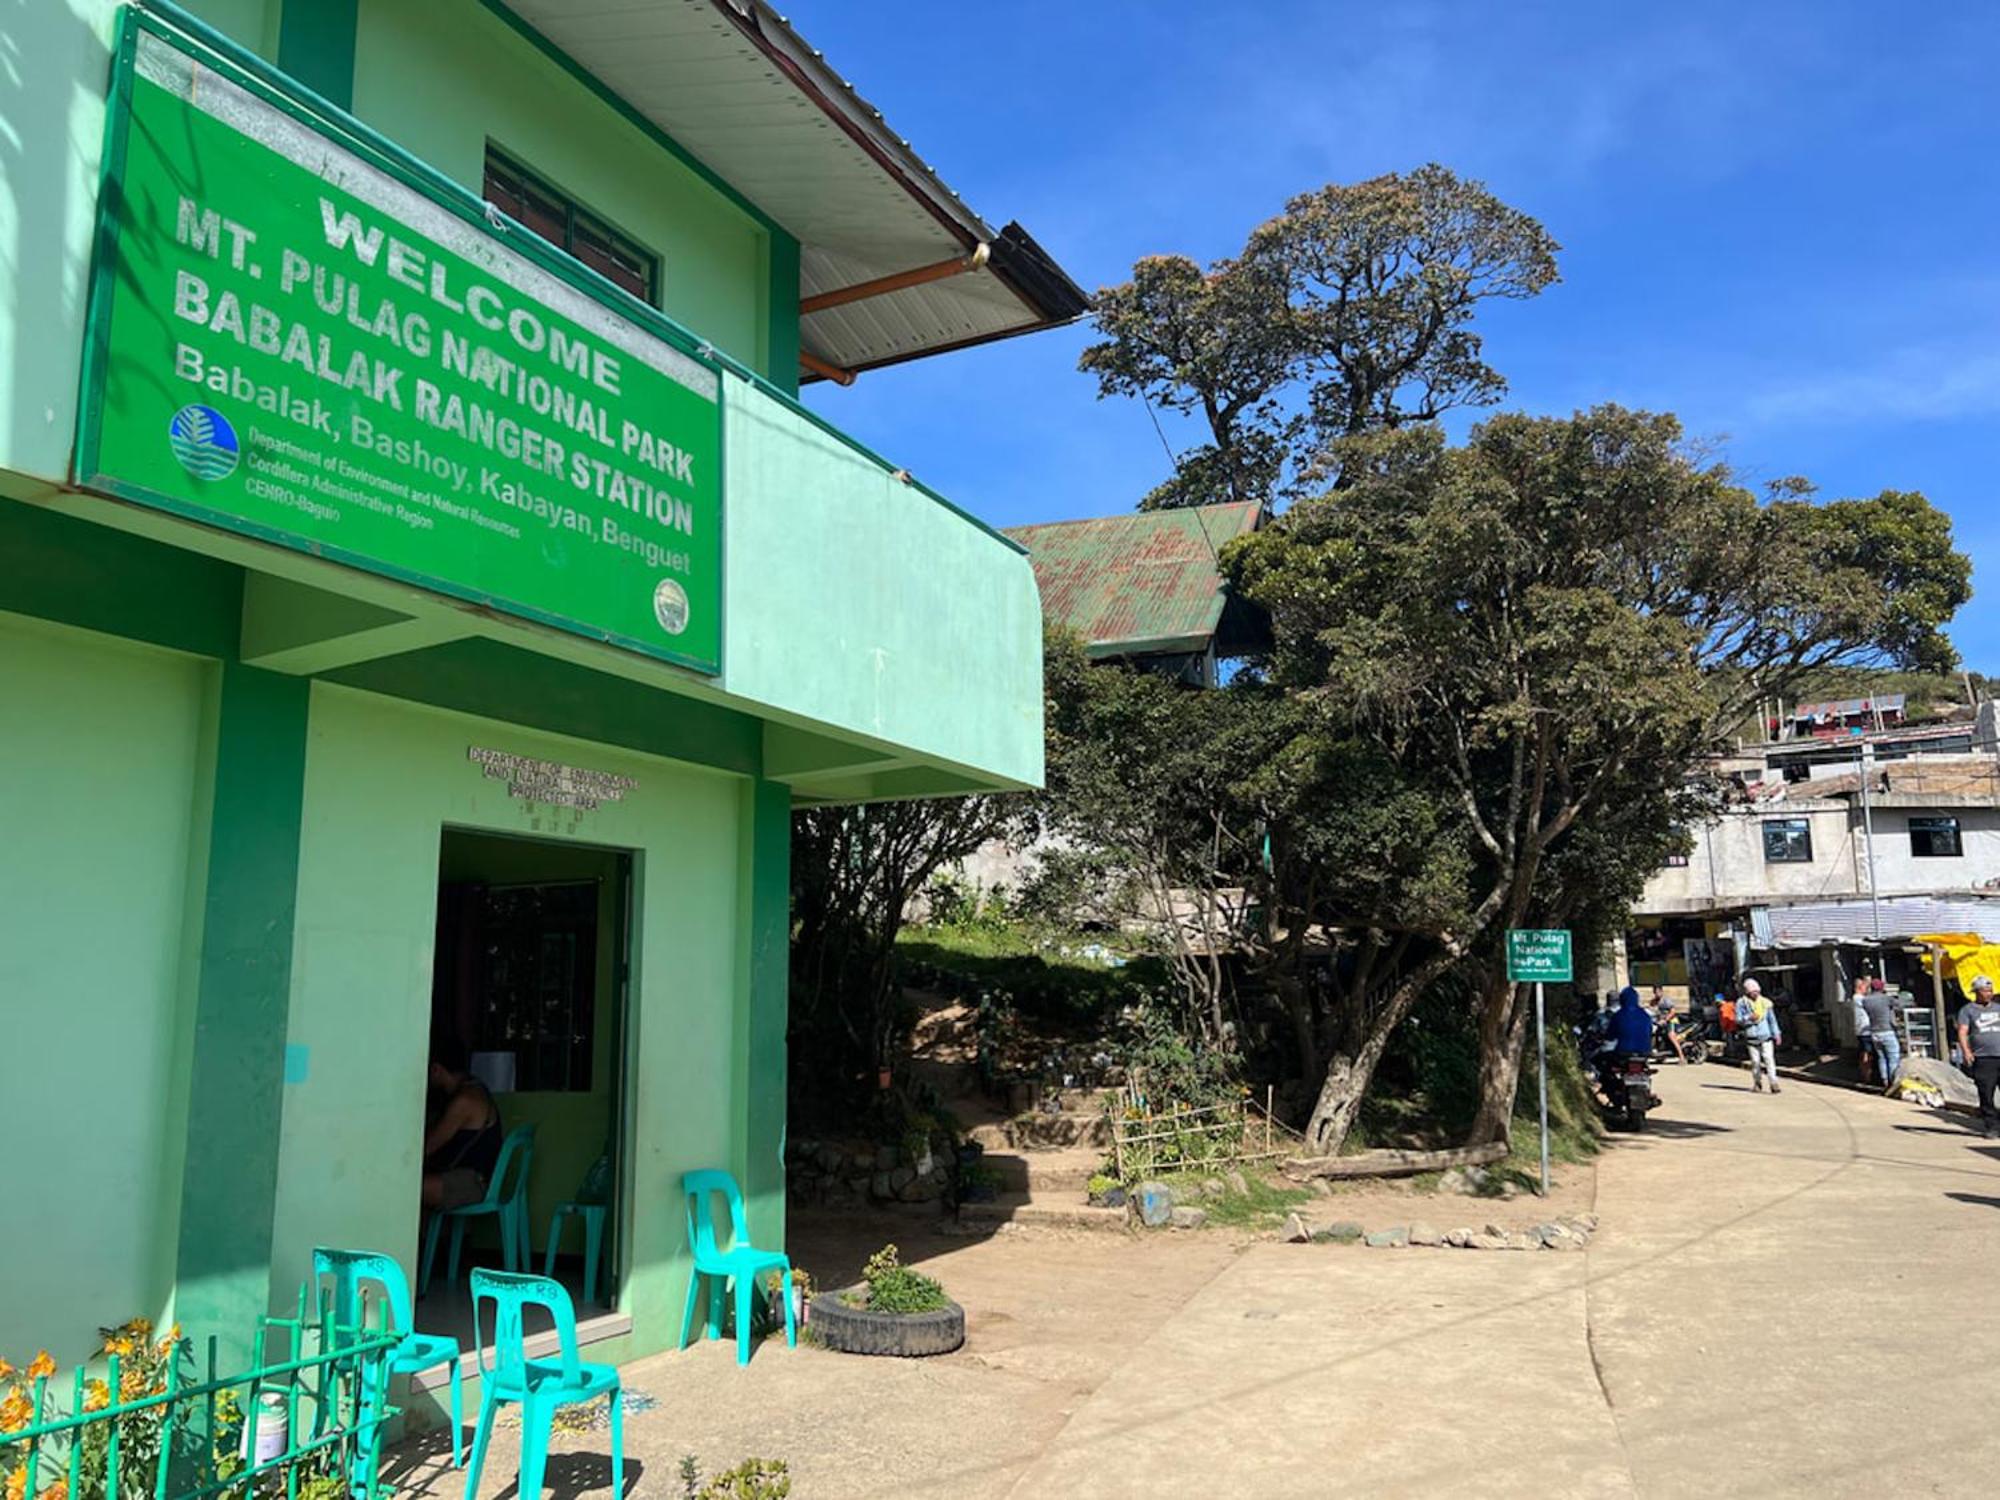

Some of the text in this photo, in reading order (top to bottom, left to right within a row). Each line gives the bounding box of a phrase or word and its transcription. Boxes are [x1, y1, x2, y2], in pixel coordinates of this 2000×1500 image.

[176, 195, 694, 486] MT. PULAG NATIONAL PARK
[319, 197, 621, 395] WELCOME
[174, 269, 693, 535] BABALAK RANGER STATION
[176, 343, 690, 575] Babalak, Bashoy, Kabayan, Benguet
[245, 477, 340, 522] CENRO-Baguio
[248, 452, 434, 530] Cordillera Administrative Region
[249, 426, 321, 466] Department
[323, 457, 337, 472] of
[338, 460, 409, 498] Environment
[411, 490, 431, 506] and
[432, 494, 470, 520] Natural
[1515, 944, 1562, 955] National
[1532, 932, 1565, 945] Pulag
